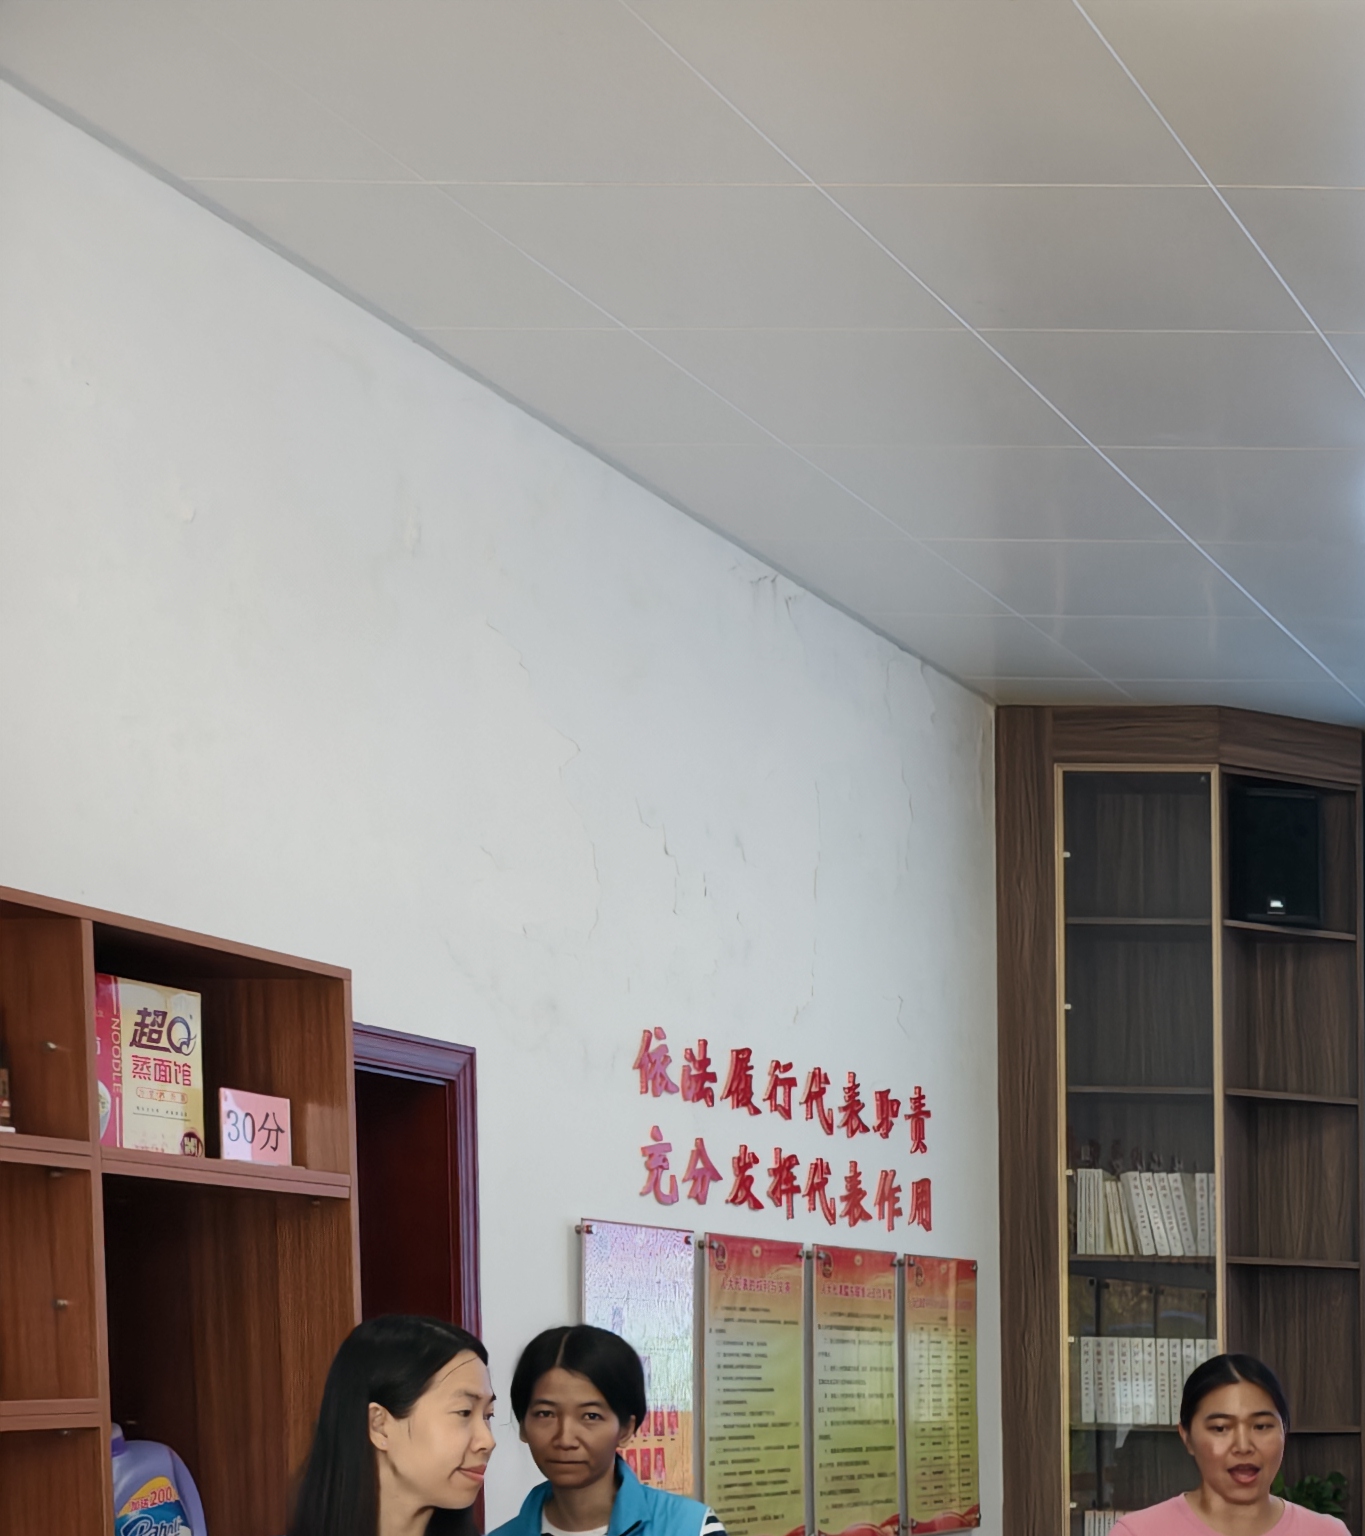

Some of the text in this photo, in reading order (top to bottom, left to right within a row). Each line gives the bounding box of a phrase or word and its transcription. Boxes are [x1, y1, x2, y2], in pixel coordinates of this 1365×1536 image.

[110, 1017, 123, 1093] NOODLE
[129, 1007, 197, 1056] 超Q
[131, 1054, 192, 1087] 蒸面馆
[226, 1109, 285, 1152] 30分
[638, 1125, 932, 1232] 充分发挥代表作用
